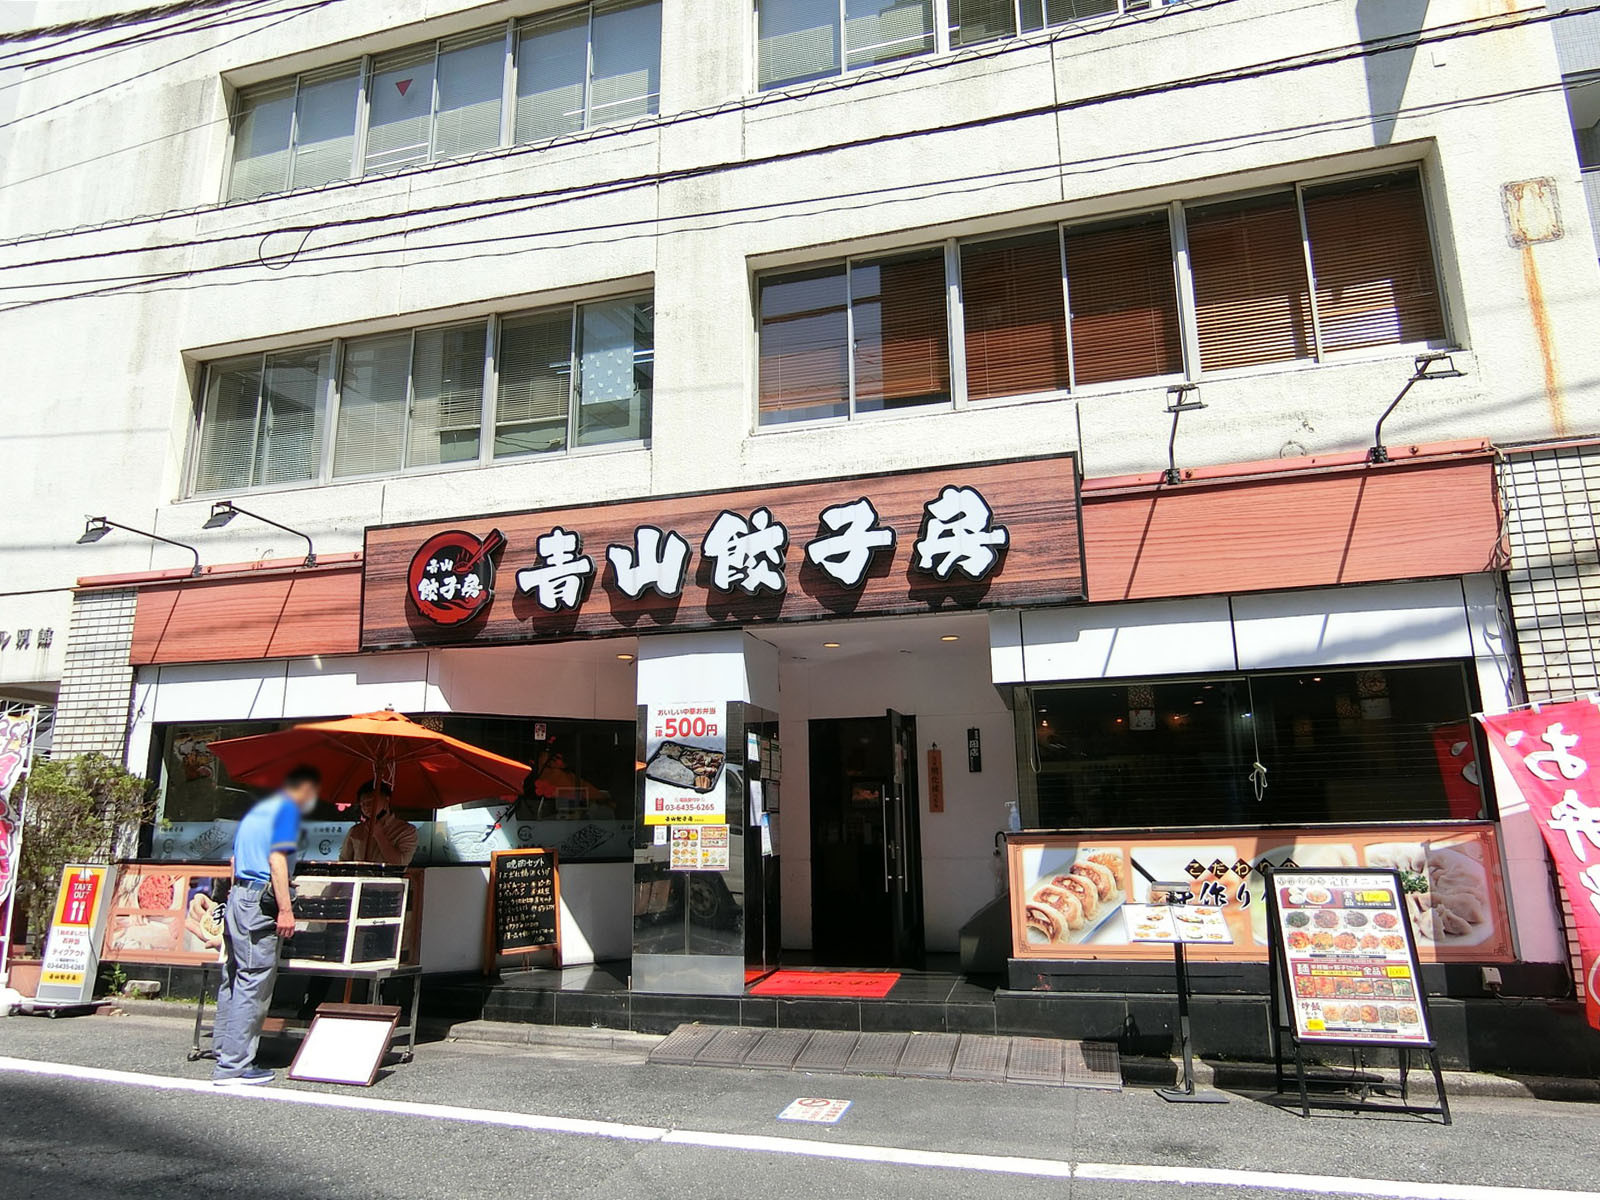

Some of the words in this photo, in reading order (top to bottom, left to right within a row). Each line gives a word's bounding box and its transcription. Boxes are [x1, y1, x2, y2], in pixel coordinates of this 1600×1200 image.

[517, 486, 1008, 610] 青山餃子房
[426, 558, 453, 574] 青山
[418, 573, 483, 601] 餃子房
[665, 717, 718, 738] 500円
[665, 803, 714, 811] 03-6435-6265
[73, 882, 93, 892] TAKE
